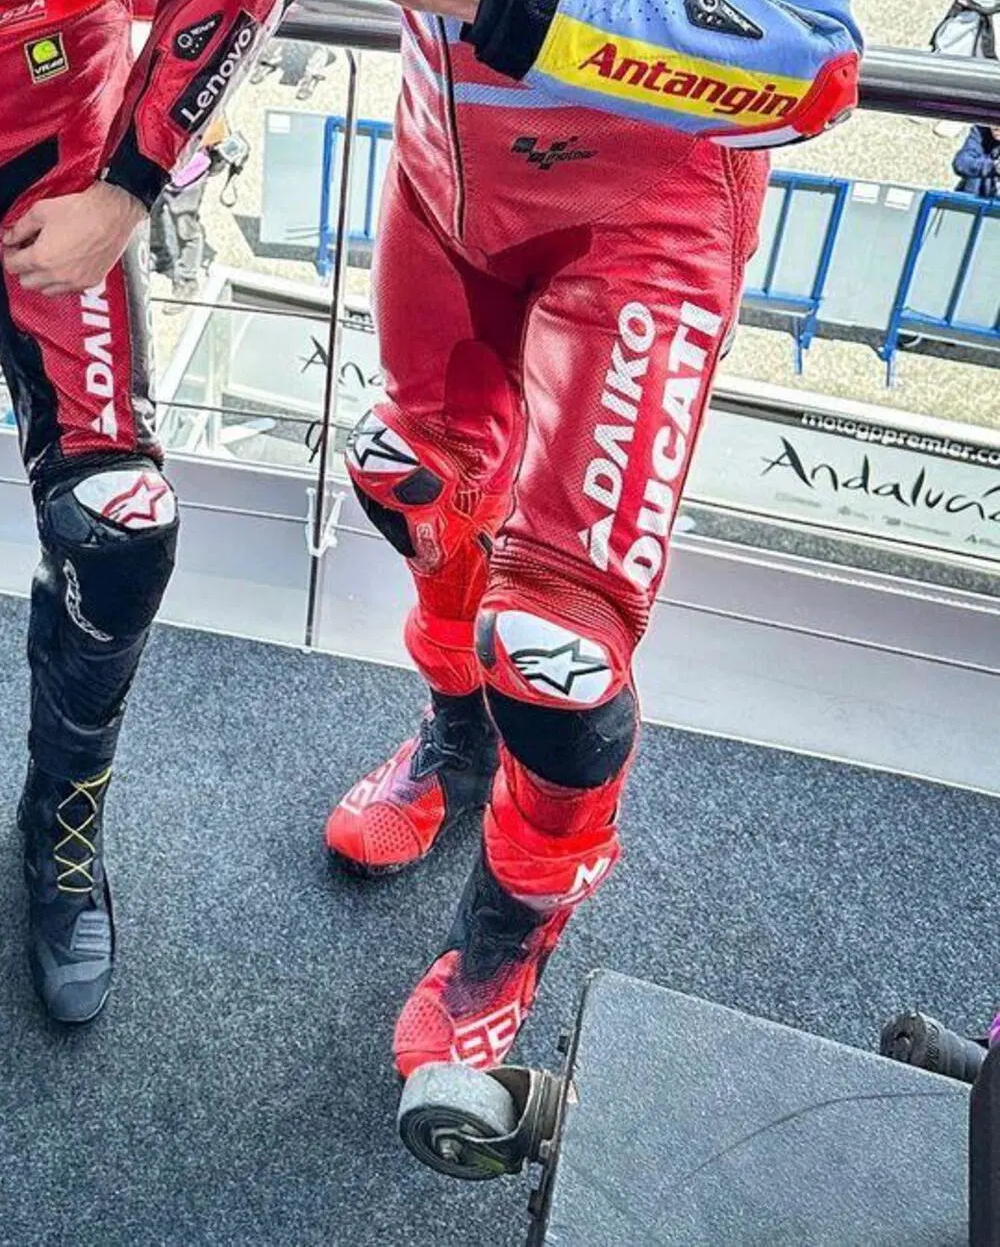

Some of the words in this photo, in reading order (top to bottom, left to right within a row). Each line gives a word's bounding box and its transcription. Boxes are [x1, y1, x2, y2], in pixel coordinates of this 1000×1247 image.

[180, 26, 252, 124] Lenovo
[578, 43, 799, 119] Antangin
[582, 300, 657, 515] DAIKO
[622, 300, 724, 587] DUCATI
